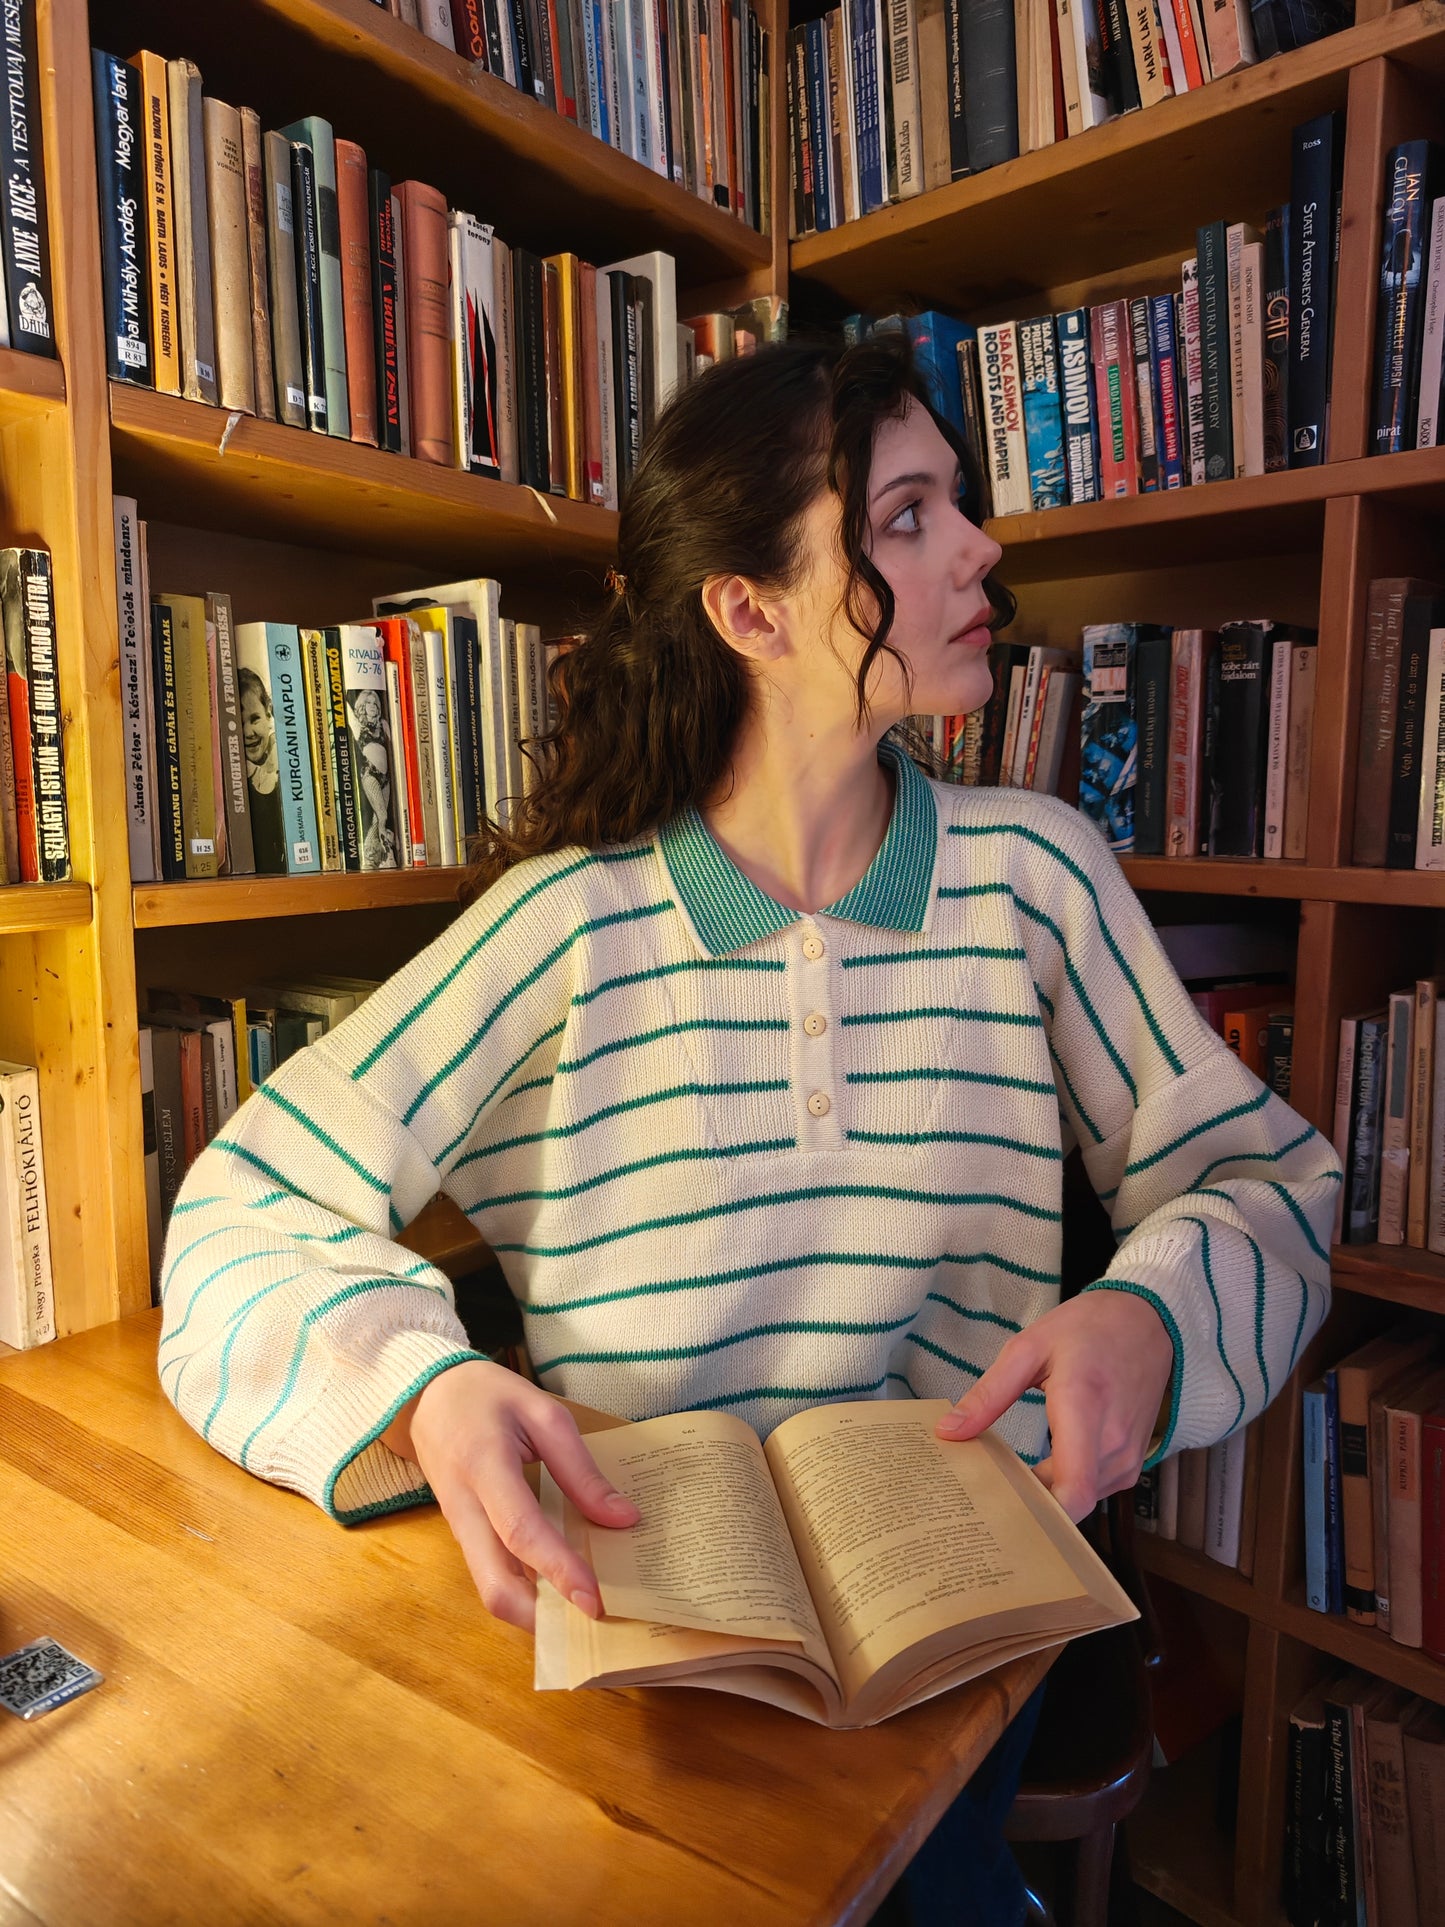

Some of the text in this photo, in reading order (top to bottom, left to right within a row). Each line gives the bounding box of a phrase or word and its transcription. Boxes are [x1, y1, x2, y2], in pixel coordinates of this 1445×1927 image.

[894, 37, 910, 84] FEHÉREN
[1137, 6, 1157, 81] MARK LANE
[7, 47, 28, 152] TESTTOLVAJ
[111, 66, 126, 101] lant
[114, 100, 133, 170] Magyar
[154, 142, 166, 180] GYÖRGY
[900, 119, 911, 154] Marko
[17, 158, 31, 171] A
[155, 181, 166, 194] ÉS
[303, 166, 312, 207] NAPSUGÁR
[1390, 156, 1408, 222] GUILLOU
[1405, 173, 1421, 201] JAN
[9, 173, 37, 224] RICE:
[157, 209, 166, 238] BARTA
[13, 220, 40, 278] ANNE
[119, 196, 136, 260] András
[158, 241, 168, 268] LAJOS
[121, 256, 141, 318] Mihály
[159, 282, 170, 306] NÉGY
[1205, 273, 1218, 337] NATURAL
[1245, 266, 1255, 325] JOHN OSBORNE
[1300, 202, 1317, 361] STATE ATTORNEYS GENERAL
[126, 340, 140, 350] 894
[161, 308, 172, 358] KISREGÉNY
[1031, 324, 1045, 383] PRELUDE TO
[1103, 308, 1118, 360] ISAAC ASIMOV
[1132, 303, 1149, 357] ISAAC ASIMOV
[1155, 299, 1171, 353] ISAAC ASIMOV
[1207, 339, 1217, 370] LAW
[133, 354, 142, 363] 83
[999, 328, 1020, 432] ISAAC ASIMOV
[1021, 325, 1036, 392] FOUNDATION
[1041, 321, 1056, 394] ISAAC ASIMOV
[1061, 339, 1090, 425] ASIMOV
[984, 331, 1011, 481] ROBOTS AND EMPIRE
[1108, 367, 1124, 460] FOUNDATION EARTH
[1160, 358, 1178, 459] FOUNDATION EMPIRE
[1187, 352, 1203, 464] GAME RAWI HAGE
[1208, 371, 1220, 430] THEORY
[1376, 425, 1401, 440] pirat
[1068, 436, 1084, 503] FOUNDATION
[1081, 432, 1095, 500] FORWARD THE
[1386, 592, 1404, 630] What
[356, 662, 382, 676] 75-76
[1242, 661, 1260, 670] zárt
[26, 575, 67, 860] SZILÁGYI ISTVÁN KŐ HULL APADÓ KÚTBA
[215, 605, 246, 814] SLAUGHTER A FRONTSEBÉSZ
[277, 673, 304, 802] KURGÁNI NAPLÓ
[419, 700, 431, 745] Küzdve
[161, 618, 184, 862] WOLFGANG OTT CÁPÁK ÉS KISHALAK
[315, 708, 327, 772] meneteléstől
[327, 647, 358, 859] MARGARET DRABBLE MALOMKŐ
[441, 739, 450, 778] PONGRÁC
[296, 806, 305, 829] MÁRIA
[321, 774, 331, 809] hosszú
[321, 808, 331, 818] A
[14, 1094, 46, 1322] Nagy Piroska FELHŐKIÁLTÓ
